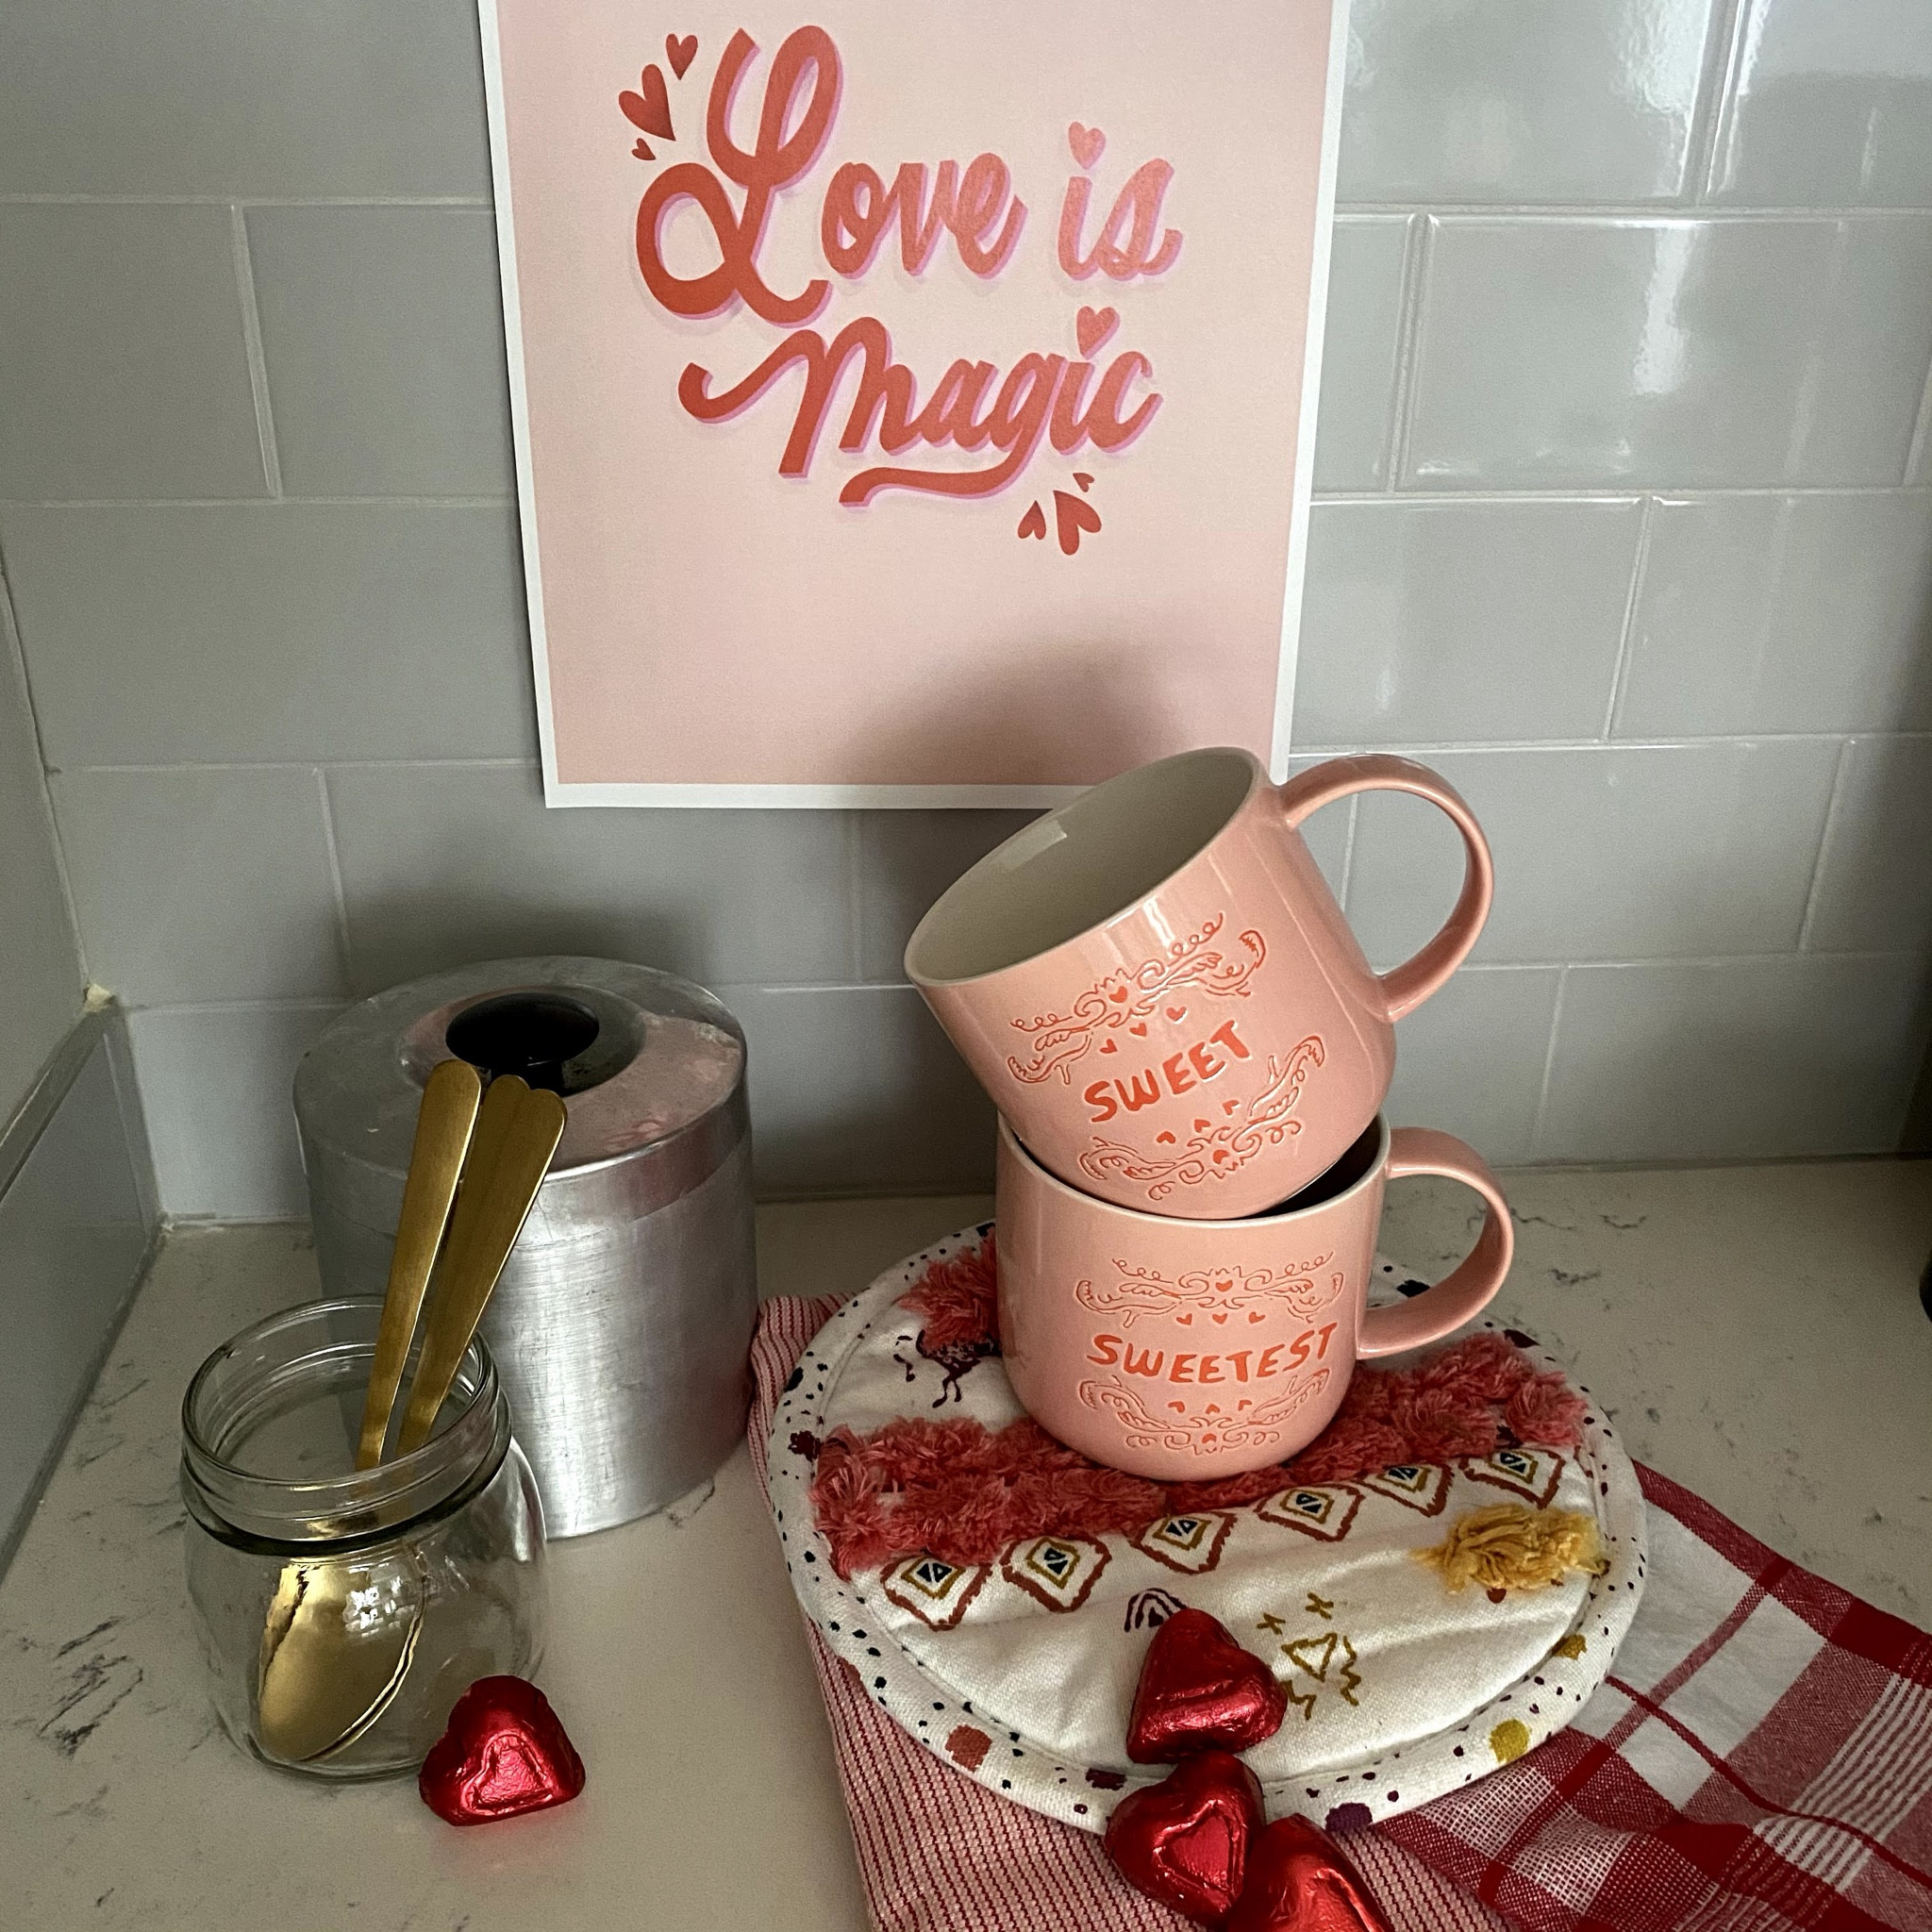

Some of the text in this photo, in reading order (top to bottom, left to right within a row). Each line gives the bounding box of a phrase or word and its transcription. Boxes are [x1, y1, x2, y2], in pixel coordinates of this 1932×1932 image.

[636, 25, 1183, 328] Love is
[1084, 1020, 1253, 1124] SWEET
[1087, 1322, 1338, 1384] SWEETEST
